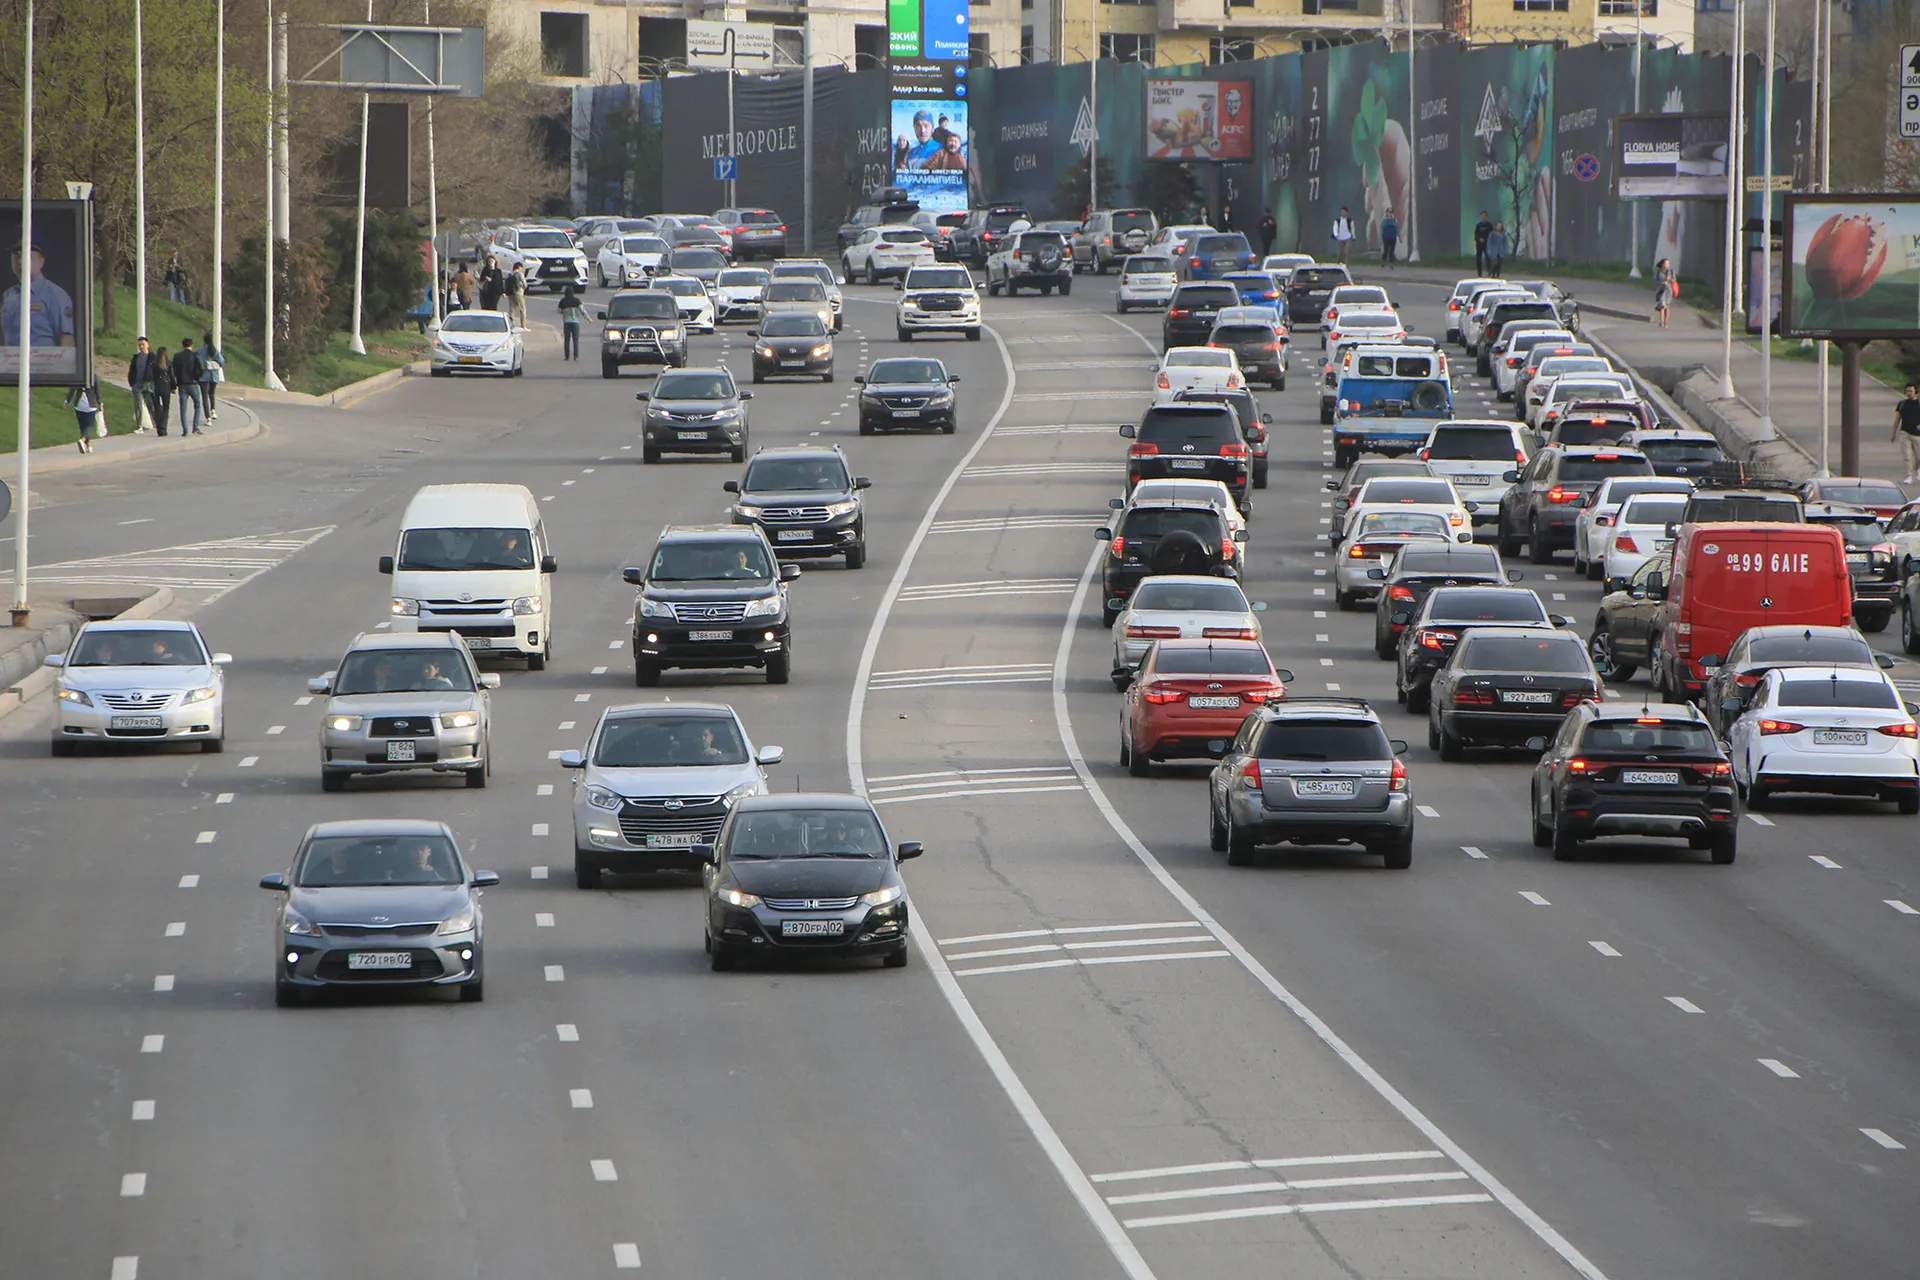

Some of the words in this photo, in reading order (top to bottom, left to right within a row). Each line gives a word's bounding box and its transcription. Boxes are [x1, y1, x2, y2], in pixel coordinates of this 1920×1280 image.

[1152, 88, 1184, 96] ТВИСТЕР
[1152, 97, 1172, 105] БОКС
[1312, 86, 1318, 110] 2
[1222, 125, 1245, 134] KFC
[1309, 116, 1320, 140] 77
[1624, 142, 1654, 152] FLORYA
[1656, 142, 1680, 152] HOME
[1014, 154, 1037, 172] ОКНА
[1309, 146, 1320, 172] 77
[896, 174, 963, 186] ПАРАЛИМПИЕЦ
[1309, 177, 1320, 202] 77
[1727, 554, 1739, 564] 08
[1228, 697, 1239, 706] 05
[150, 718, 160, 726] 02
[398, 742, 414, 750] 826
[388, 751, 398, 760] 02
[1631, 773, 1648, 782] 642
[1666, 774, 1677, 782] 02
[1306, 781, 1322, 790] 485
[1340, 782, 1352, 791] 02
[656, 835, 672, 844] 478
[690, 834, 702, 844] 02
[792, 922, 810, 932] 870
[830, 922, 842, 932] 02
[358, 954, 376, 965] 720
[397, 954, 410, 964] 02
